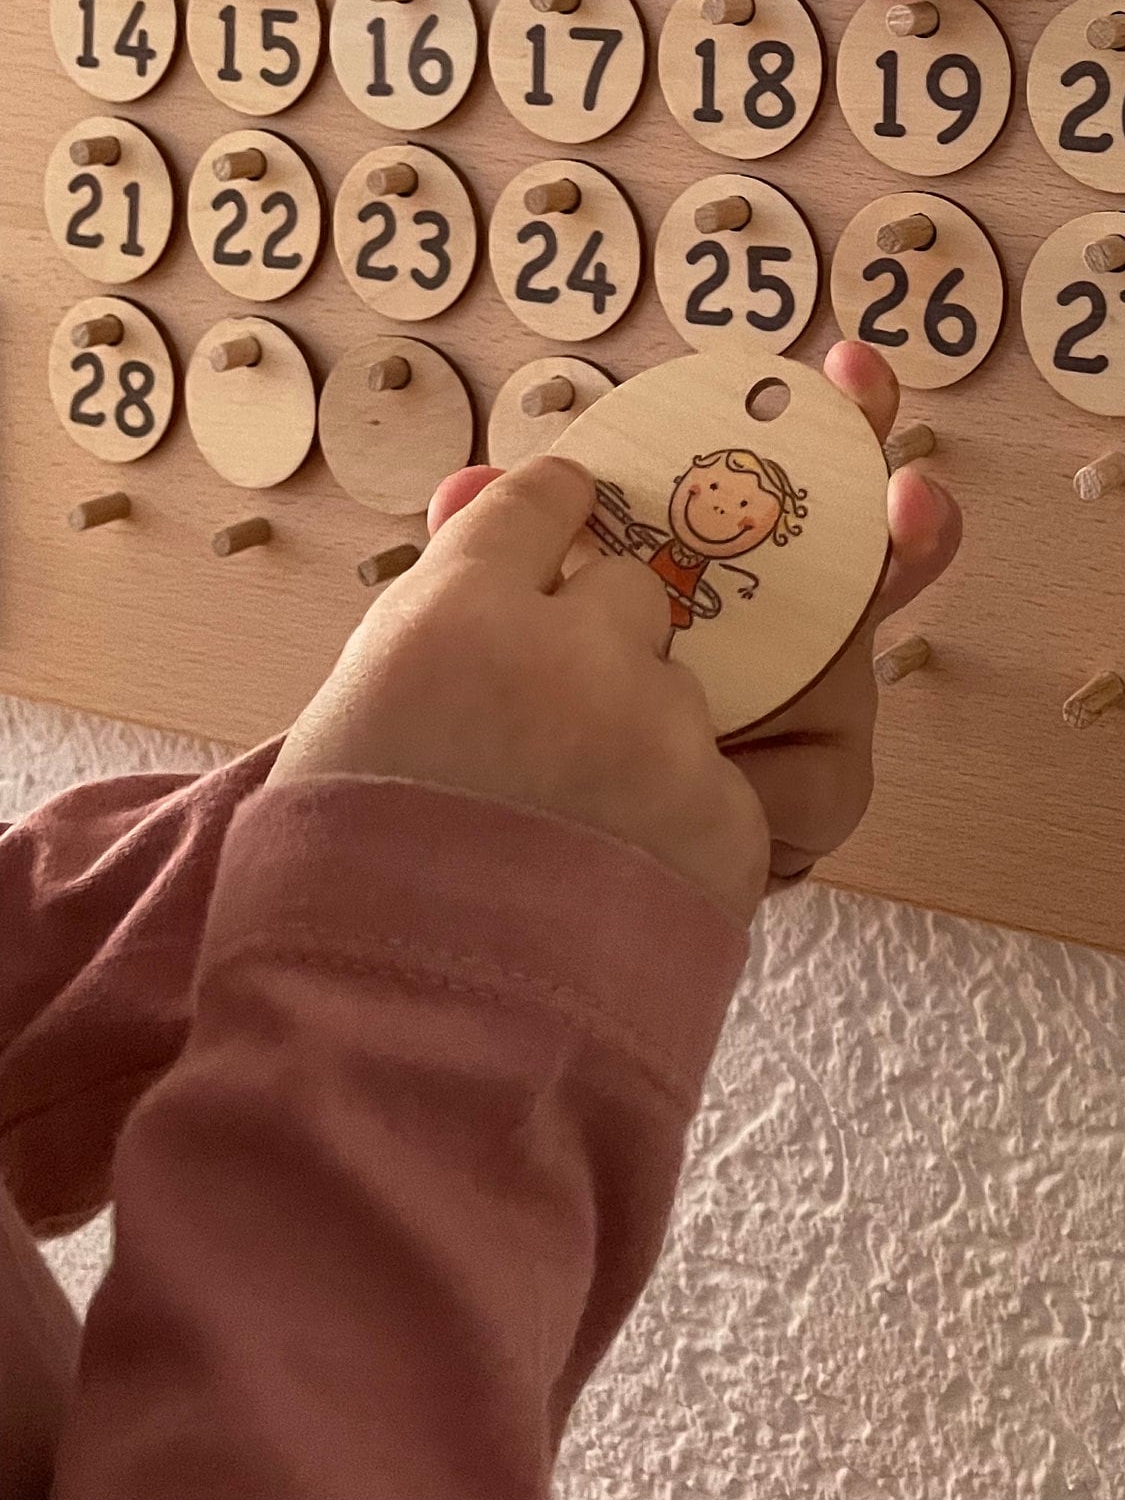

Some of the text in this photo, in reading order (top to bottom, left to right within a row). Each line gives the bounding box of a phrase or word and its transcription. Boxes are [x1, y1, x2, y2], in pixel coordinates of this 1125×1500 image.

[217, 5, 301, 87] 15
[366, 13, 454, 96] 16
[523, 24, 623, 111] 17
[692, 37, 796, 129] 18
[873, 49, 982, 145] 19
[65, 173, 145, 257] 21
[211, 189, 302, 270] 22
[355, 200, 451, 290] 23
[515, 221, 617, 315] 24
[685, 240, 795, 332] 25
[858, 257, 978, 358] 26
[68, 352, 155, 438] 28
